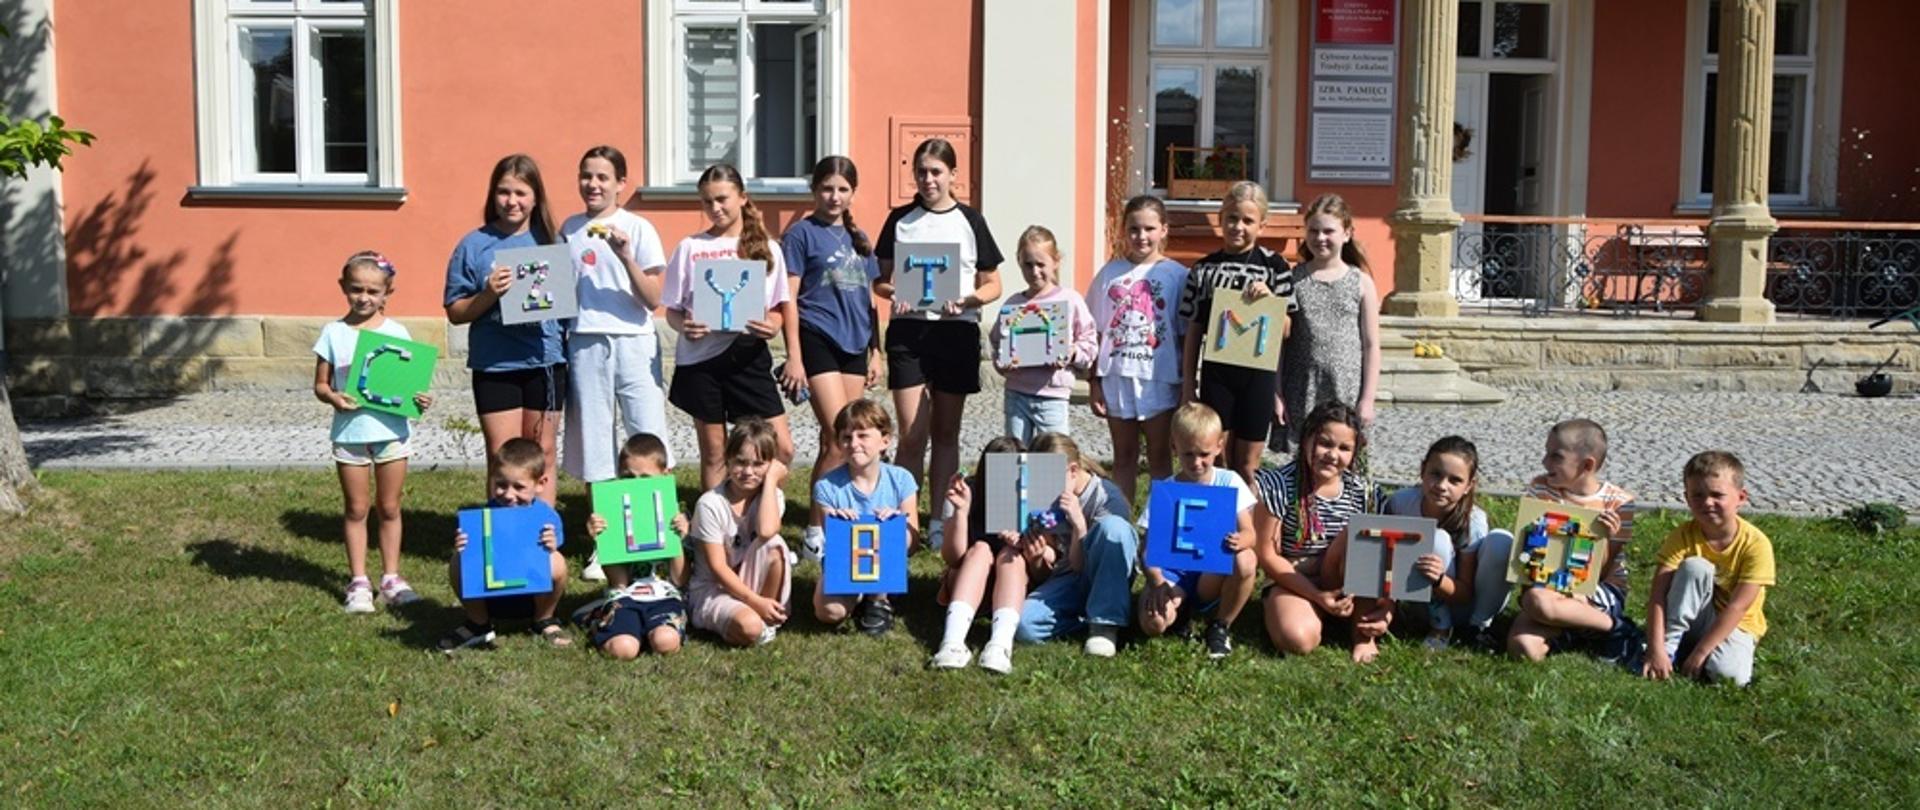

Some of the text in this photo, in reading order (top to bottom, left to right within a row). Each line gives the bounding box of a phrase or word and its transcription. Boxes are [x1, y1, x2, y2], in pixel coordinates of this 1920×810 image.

[1320, 62, 1389, 72] Tradycji Lokalnej
[1352, 53, 1389, 61] Archiwum
[1347, 86, 1387, 96] PAMIĘCI
[704, 268, 749, 332] Y
[908, 254, 949, 303] T
[1009, 303, 1053, 356] A
[1215, 308, 1271, 356] M
[357, 345, 412, 407] C
[622, 490, 665, 552] U
[483, 508, 528, 589] L
[1355, 527, 1423, 600] T
